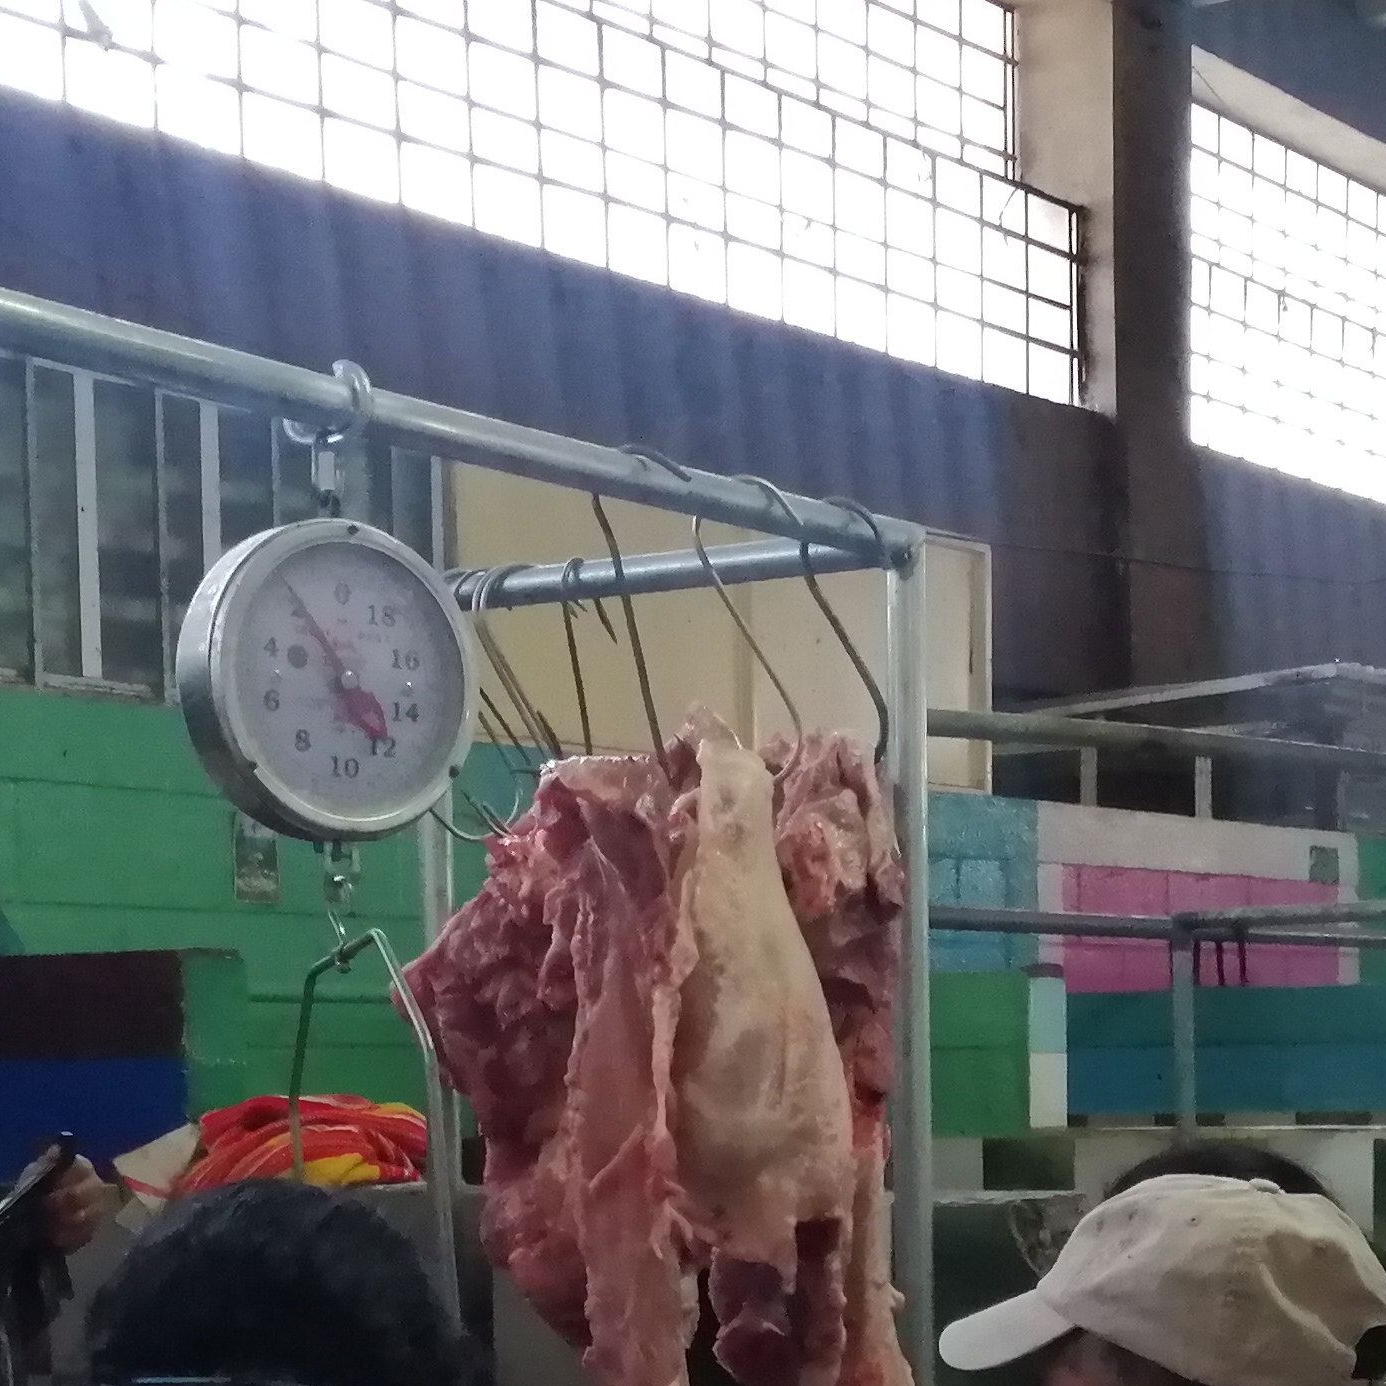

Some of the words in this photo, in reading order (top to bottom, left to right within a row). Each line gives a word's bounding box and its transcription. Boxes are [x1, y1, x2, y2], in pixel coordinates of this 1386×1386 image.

[334, 582, 351, 605] 0
[368, 604, 396, 627] 18
[264, 636, 279, 657] 4
[391, 648, 420, 670] 16
[264, 689, 280, 711] 6
[392, 701, 420, 722] 14
[294, 729, 311, 752] 8
[369, 735, 396, 758] 12
[330, 755, 360, 779] 10
